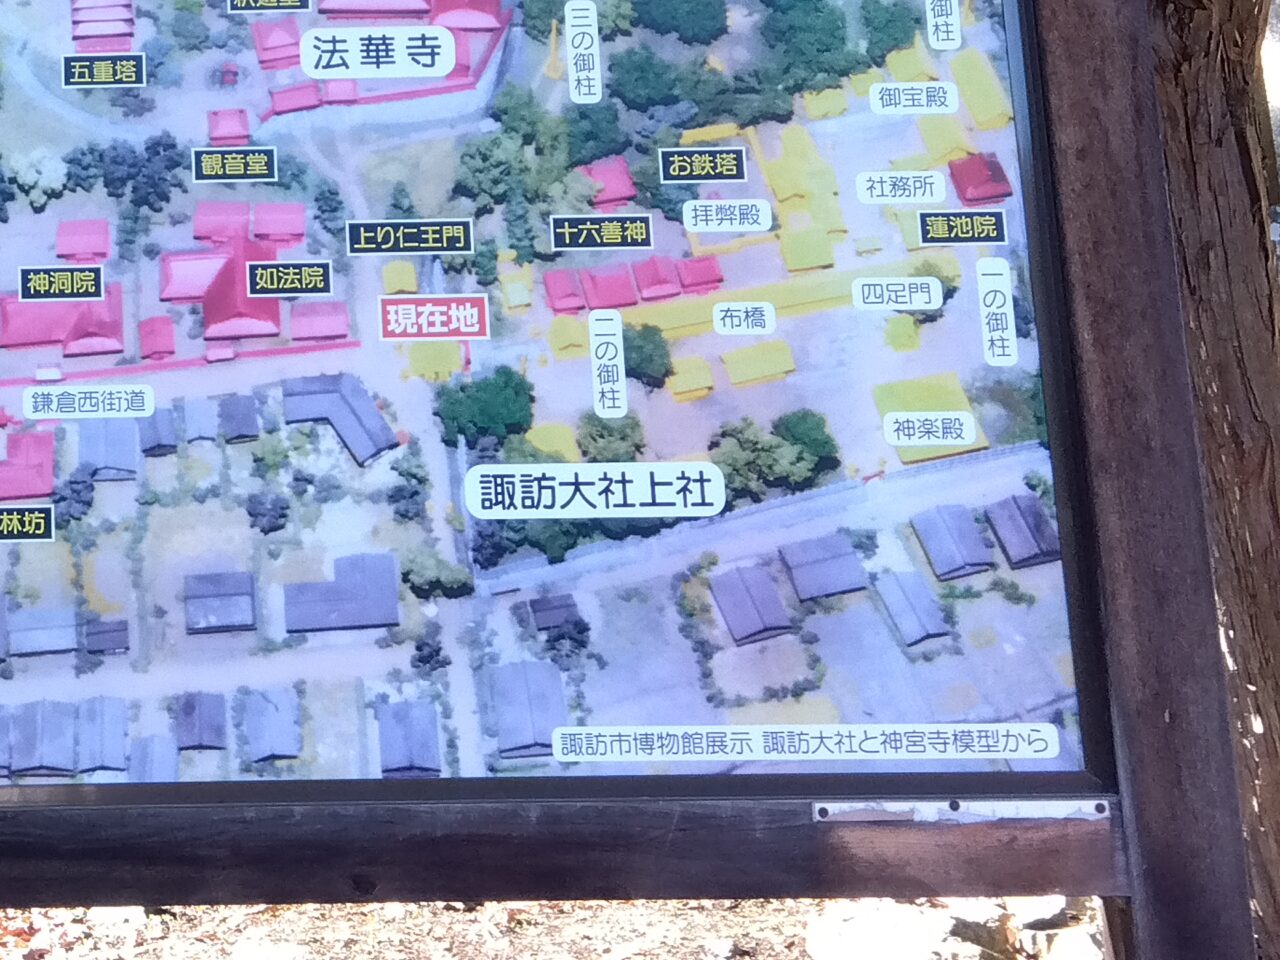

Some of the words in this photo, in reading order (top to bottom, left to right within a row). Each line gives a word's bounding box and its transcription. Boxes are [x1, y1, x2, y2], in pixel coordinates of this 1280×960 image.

[312, 34, 443, 72] 法華寺
[570, 7, 598, 98] 三の御柱
[69, 60, 137, 83] 五重塔
[878, 86, 950, 109] 御宝殿
[200, 153, 269, 176] 観音堂
[669, 153, 738, 176] お鉄塔
[865, 175, 935, 198] 社務所
[353, 225, 465, 249] 上り仁王門
[556, 222, 647, 245] 十六善神
[926, 215, 997, 238] 蓮池院
[27, 272, 96, 295] 神洞院
[255, 267, 325, 290] 如法院
[861, 282, 932, 306] 四足門
[386, 303, 481, 334] 現在地
[719, 306, 767, 330] 布橋
[980, 270, 1012, 359] 一の御柱
[594, 316, 623, 411] 二の御柱
[30, 390, 148, 415] 鎌倉西街道
[892, 417, 965, 441] 神楽殿
[479, 470, 715, 511] 諏訪大社上社
[560, 729, 754, 757] 諏訪市博物館展示
[762, 727, 1049, 755] 諏訪大社と神宮寺模型から
